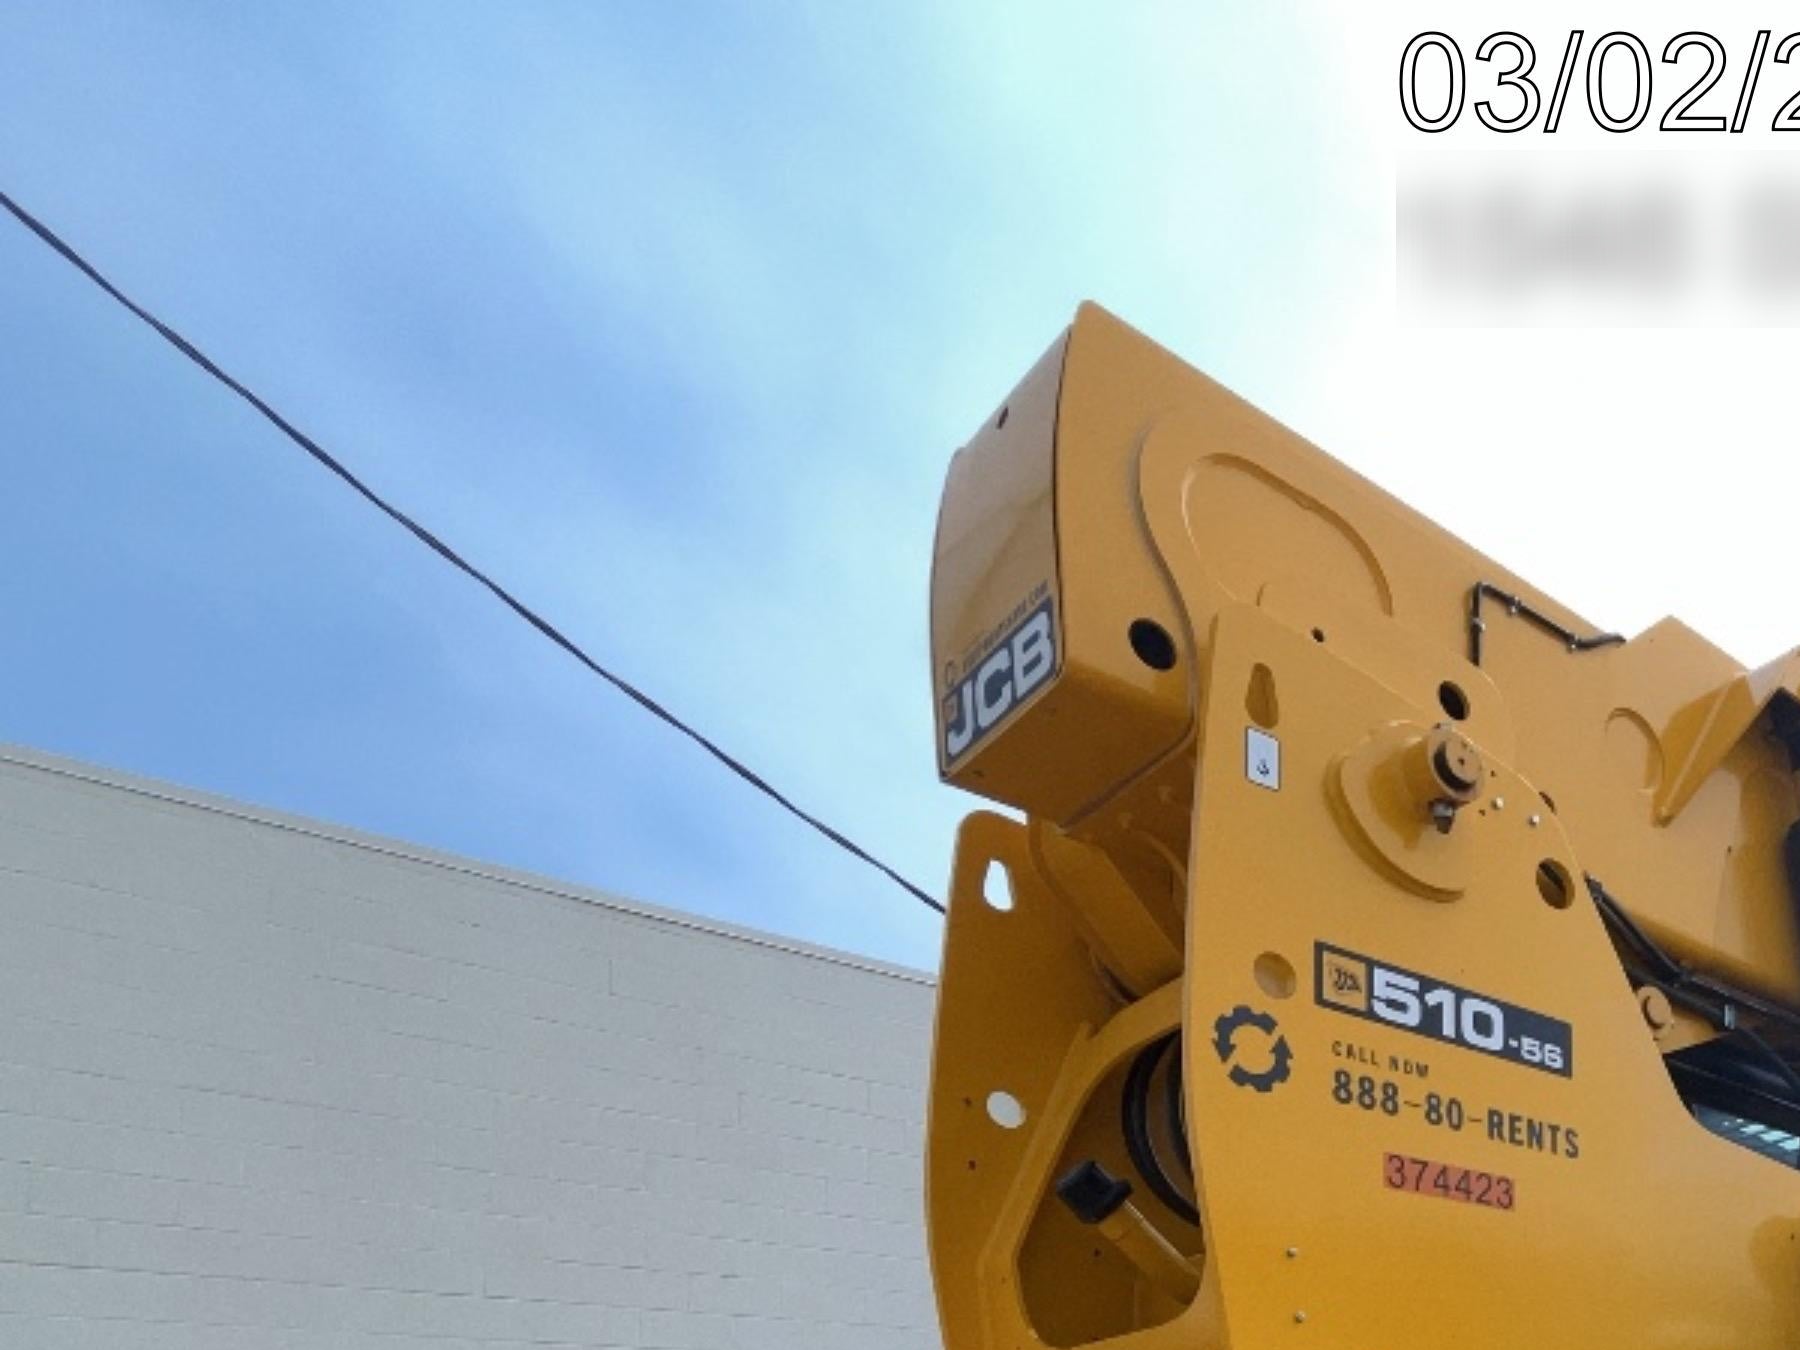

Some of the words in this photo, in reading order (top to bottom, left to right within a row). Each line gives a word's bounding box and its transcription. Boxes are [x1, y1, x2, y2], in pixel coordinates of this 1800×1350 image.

[946, 610, 1052, 757] JCB
[1332, 1040, 1380, 1067] CALL
[1388, 1055, 1429, 1078] NOW
[1332, 1068, 1580, 1159] 888-80-RENTS
[1387, 1154, 1515, 1210] 374423
